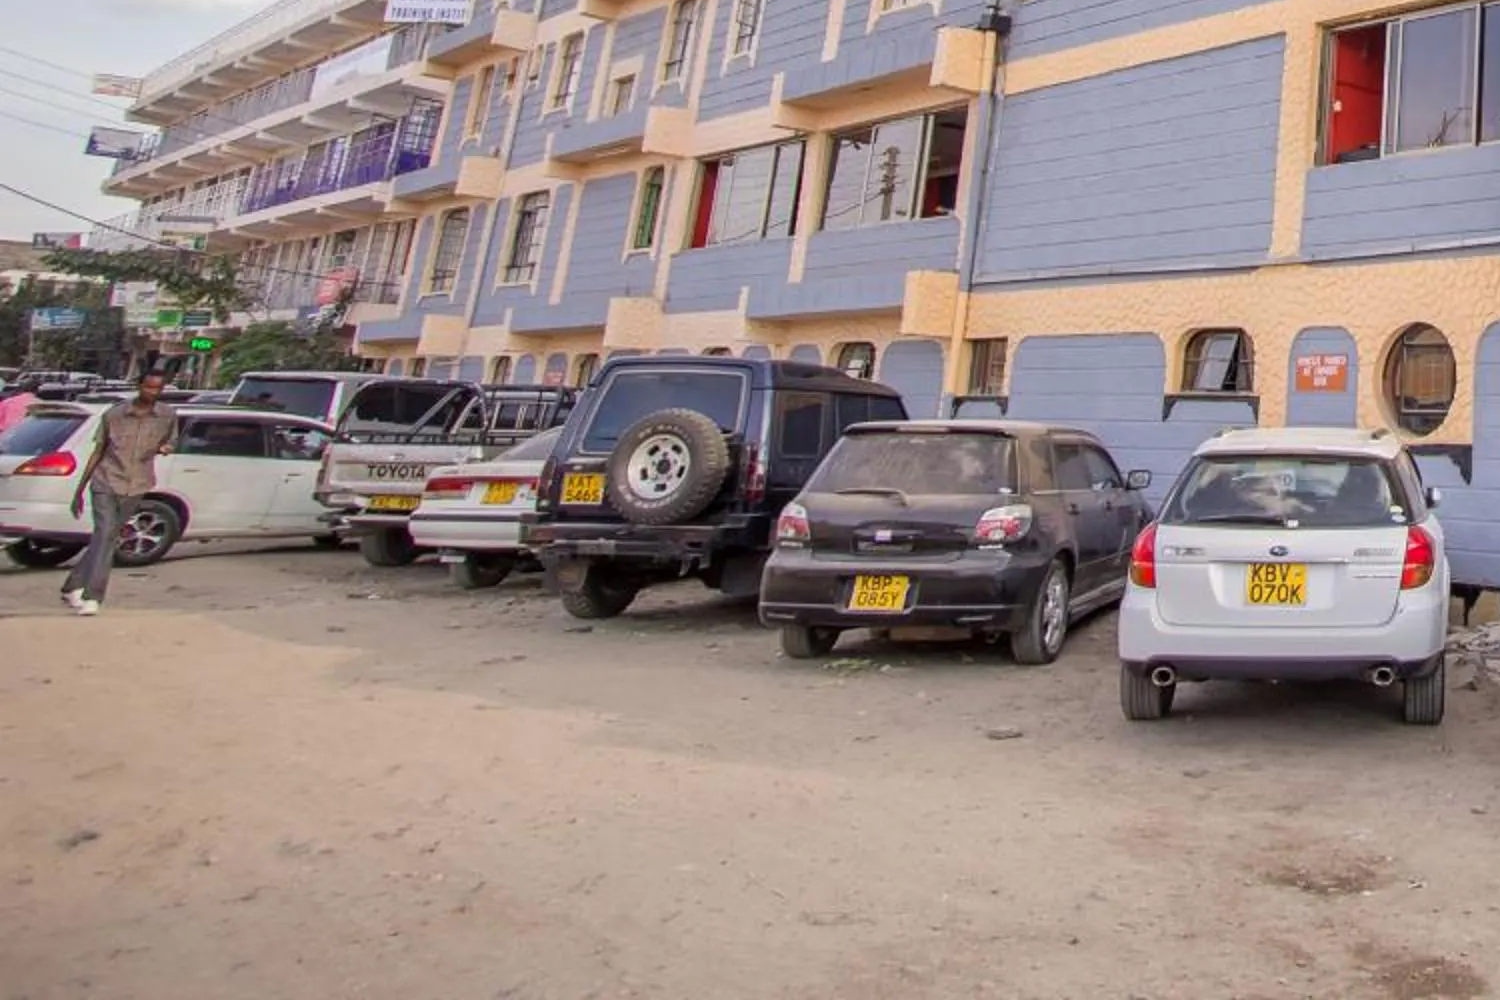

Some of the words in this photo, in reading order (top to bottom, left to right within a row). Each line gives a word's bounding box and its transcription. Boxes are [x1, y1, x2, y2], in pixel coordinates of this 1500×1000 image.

[392, 7, 433, 19] TRAINING
[367, 464, 425, 479] TOYOTA
[567, 475, 593, 488] KAT
[1251, 563, 1290, 582] KBV
[861, 575, 892, 590] KBP
[857, 591, 899, 606] 085Y
[1250, 583, 1302, 604] 070K
